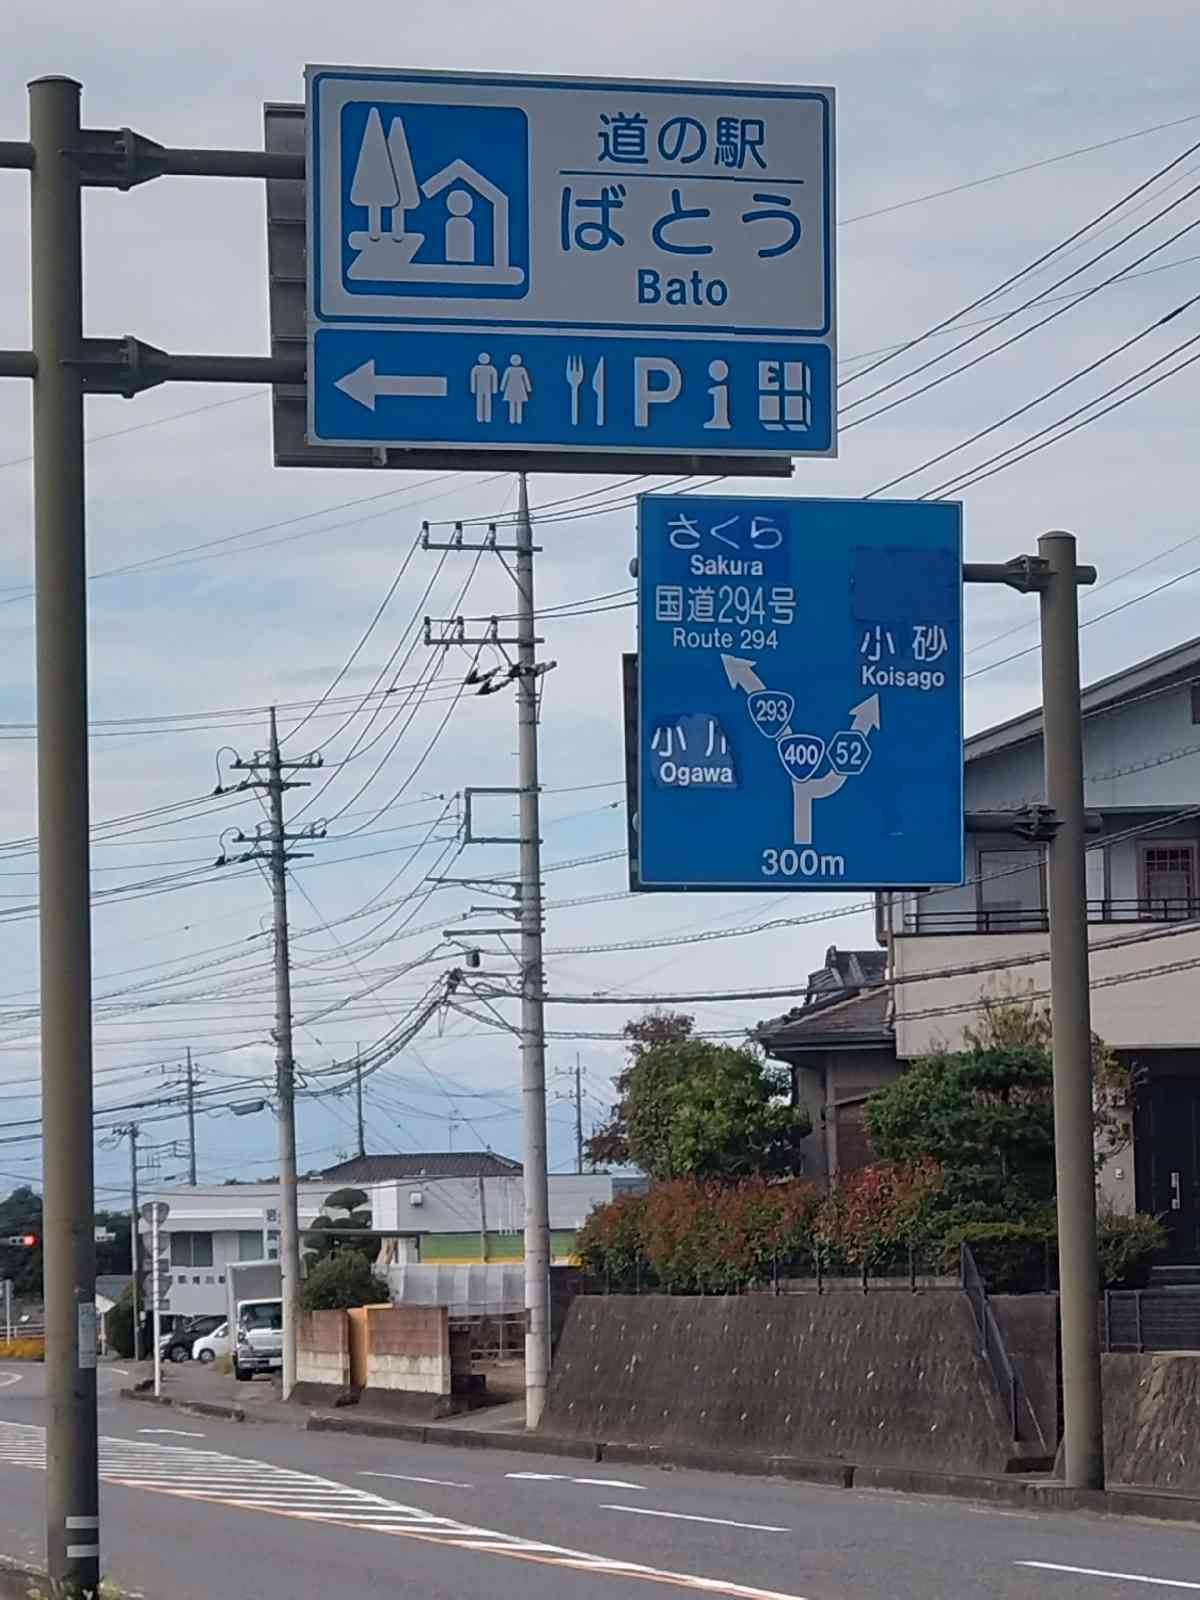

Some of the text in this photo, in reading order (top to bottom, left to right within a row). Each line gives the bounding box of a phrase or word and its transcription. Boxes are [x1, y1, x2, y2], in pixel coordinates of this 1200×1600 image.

[597, 111, 767, 169] 道の駅
[561, 184, 802, 258] ばとう
[637, 269, 729, 306] Bato
[633, 356, 682, 427] P
[667, 513, 783, 549] さくら
[690, 554, 764, 576] Sakura
[655, 585, 797, 625] 国道294号
[672, 627, 778, 649] Route 294
[860, 625, 949, 662] 小砂
[862, 665, 945, 690] Koisago
[756, 700, 788, 722] 293
[784, 744, 819, 765] 400
[835, 741, 862, 765] 52
[659, 762, 733, 785] Ogawa
[761, 849, 845, 875] 300m
